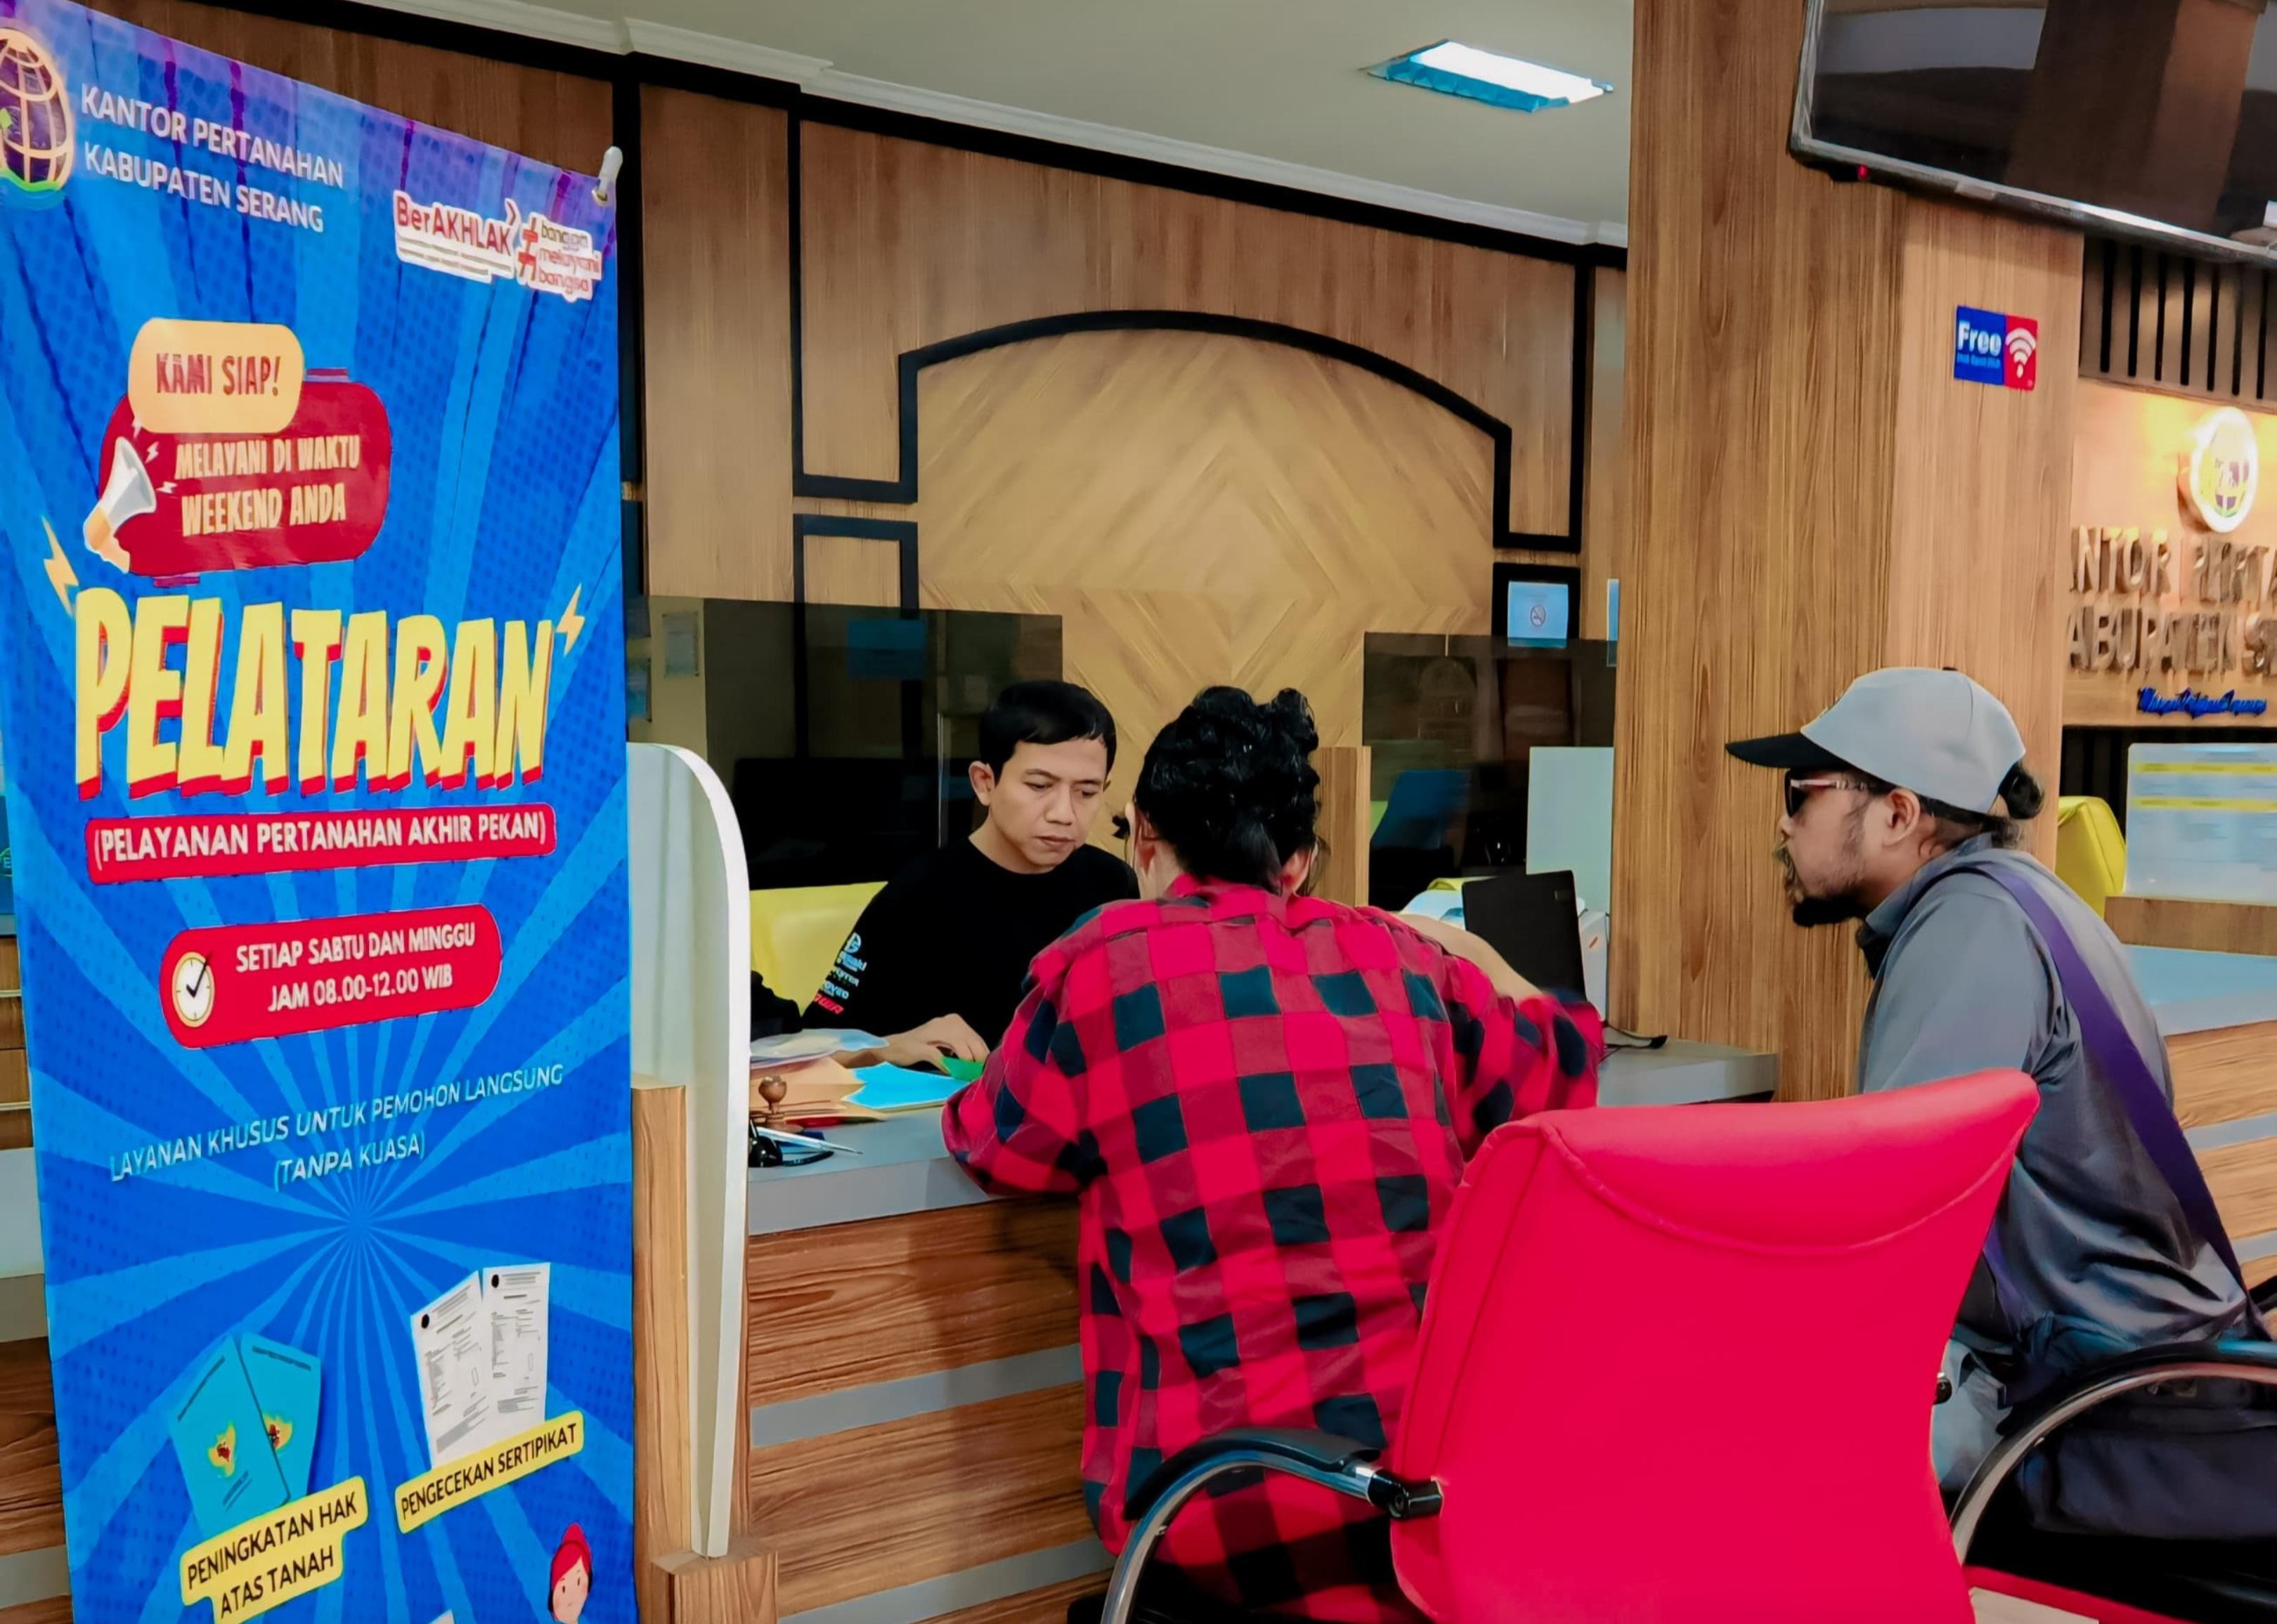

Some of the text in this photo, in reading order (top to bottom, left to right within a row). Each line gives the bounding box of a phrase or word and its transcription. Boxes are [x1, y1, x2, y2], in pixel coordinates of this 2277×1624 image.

[82, 83, 344, 188] KANTOR PERTANAHAN
[84, 141, 325, 233] KABUPATEN SERANG
[396, 196, 511, 256] BerAKHLAK
[1957, 320, 2002, 356] Free
[156, 353, 281, 396] KAMI SIAP!
[175, 434, 360, 480] MELAYANI DI WAKTU
[181, 482, 346, 536] WEEKEND ANDA
[75, 587, 554, 800] PELATARAN
[94, 811, 546, 871] (PELAYANAN PERTANAHAN AKHIR PEKAN)
[235, 922, 475, 973] SETIAP SABTU DAN MINGGU
[268, 963, 453, 1012] JAM 08.00-12.00 WIB
[110, 1064, 564, 1182] LAYANAN KHUSUS UNTUK PEMOHON LANGSUNG
[274, 1129, 425, 1193] (TANPA KUASA)
[401, 1422, 576, 1520] PENGECEKAN SERTIPIKAT
[188, 1491, 357, 1590] PENINGKATAN HAK
[221, 1545, 334, 1619] ATAS TANAH
